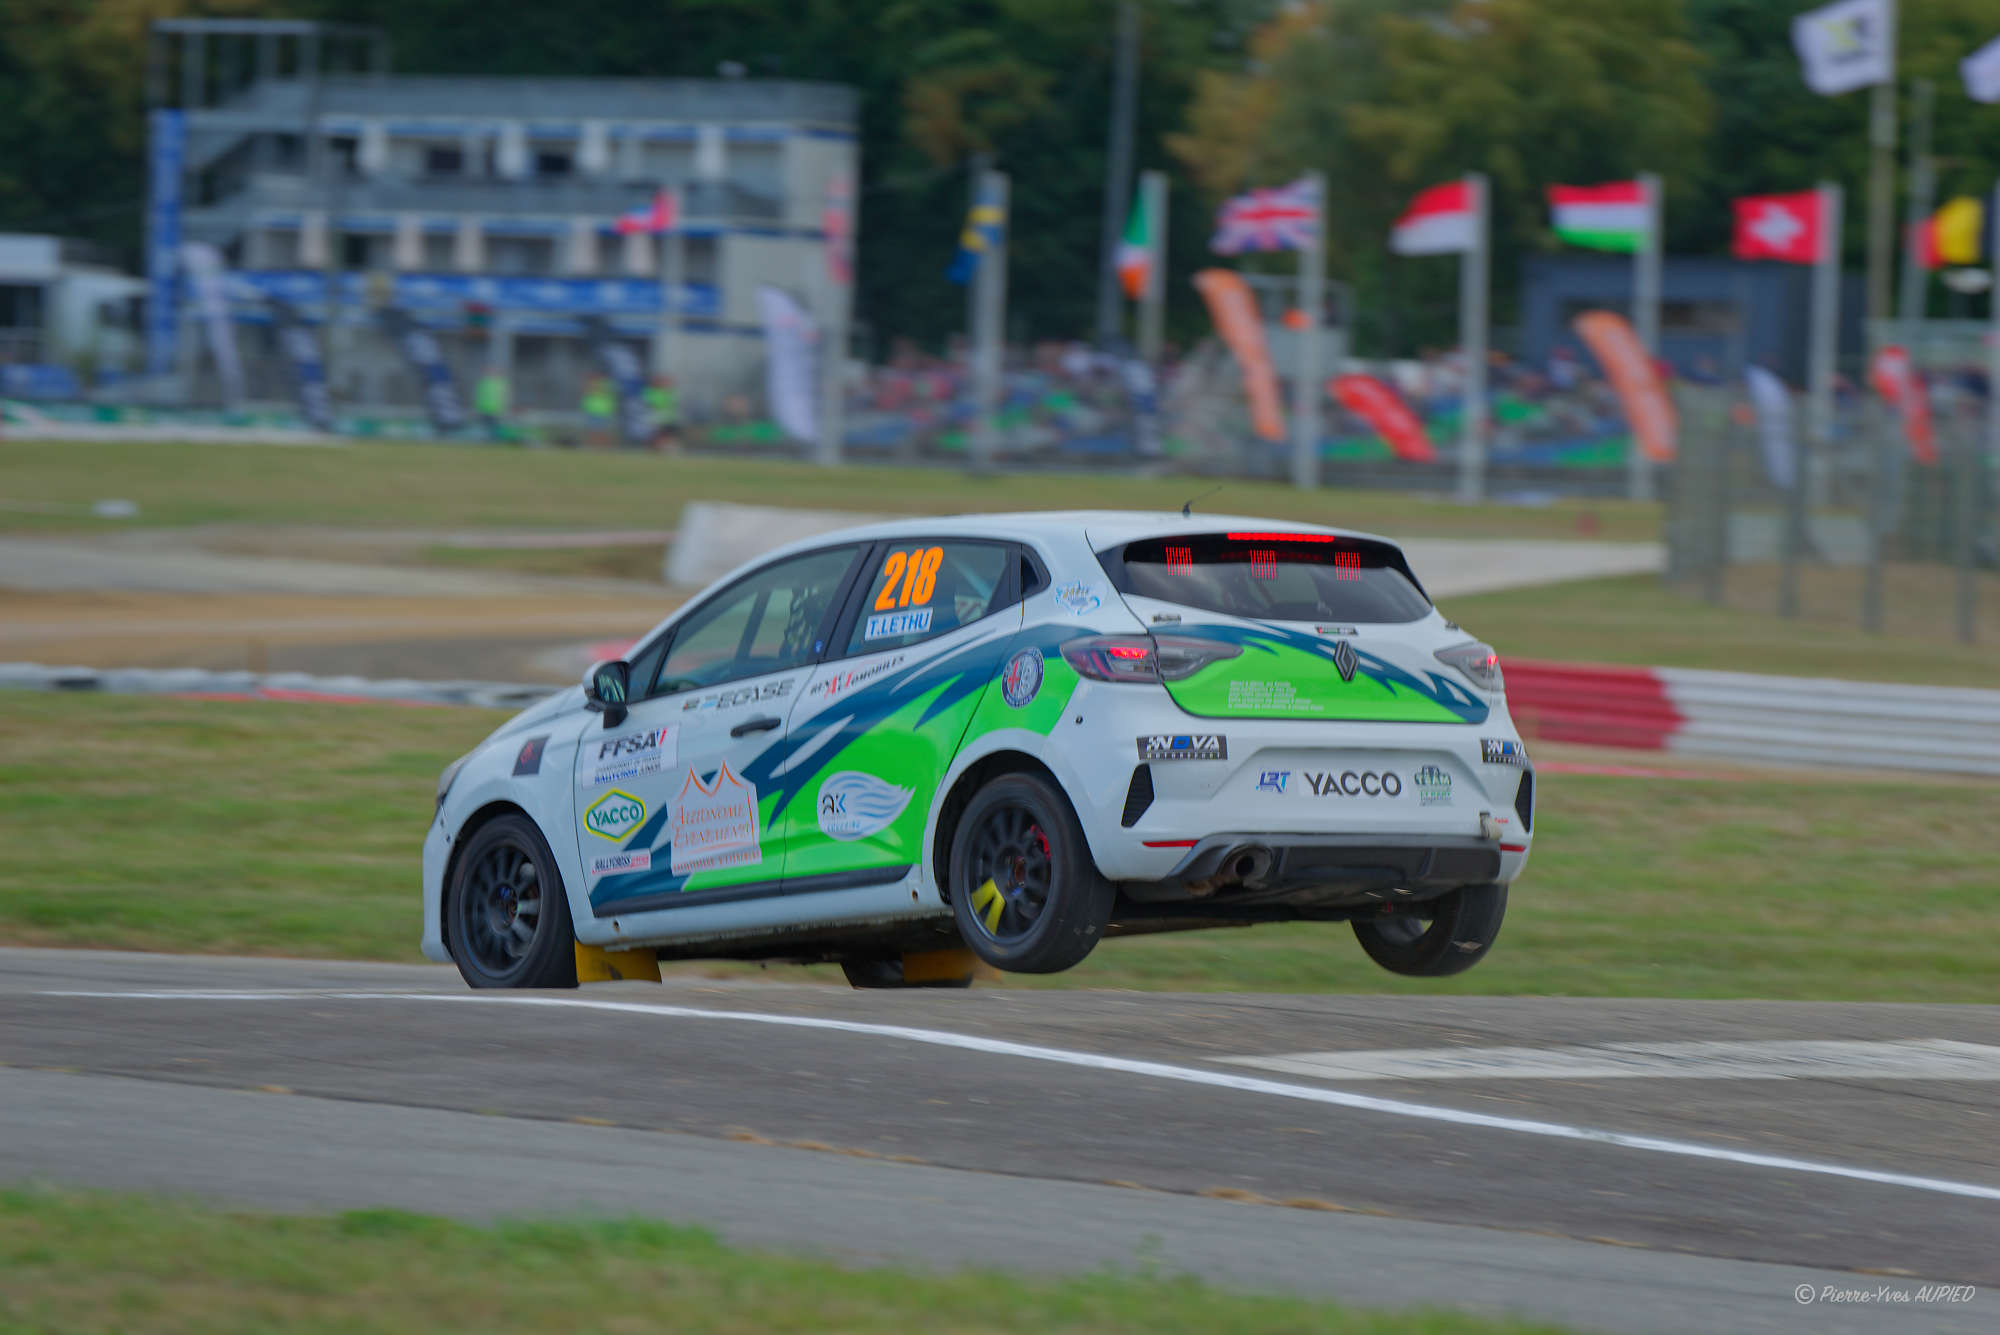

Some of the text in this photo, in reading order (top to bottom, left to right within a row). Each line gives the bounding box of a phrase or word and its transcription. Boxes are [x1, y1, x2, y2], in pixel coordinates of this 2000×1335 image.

[874, 546, 944, 611] 218
[870, 611, 930, 636] T.LETHU
[598, 732, 656, 760] FFSA
[1155, 735, 1220, 751] NOVA
[1303, 771, 1402, 796] YACCO
[591, 804, 640, 827] YACCO
